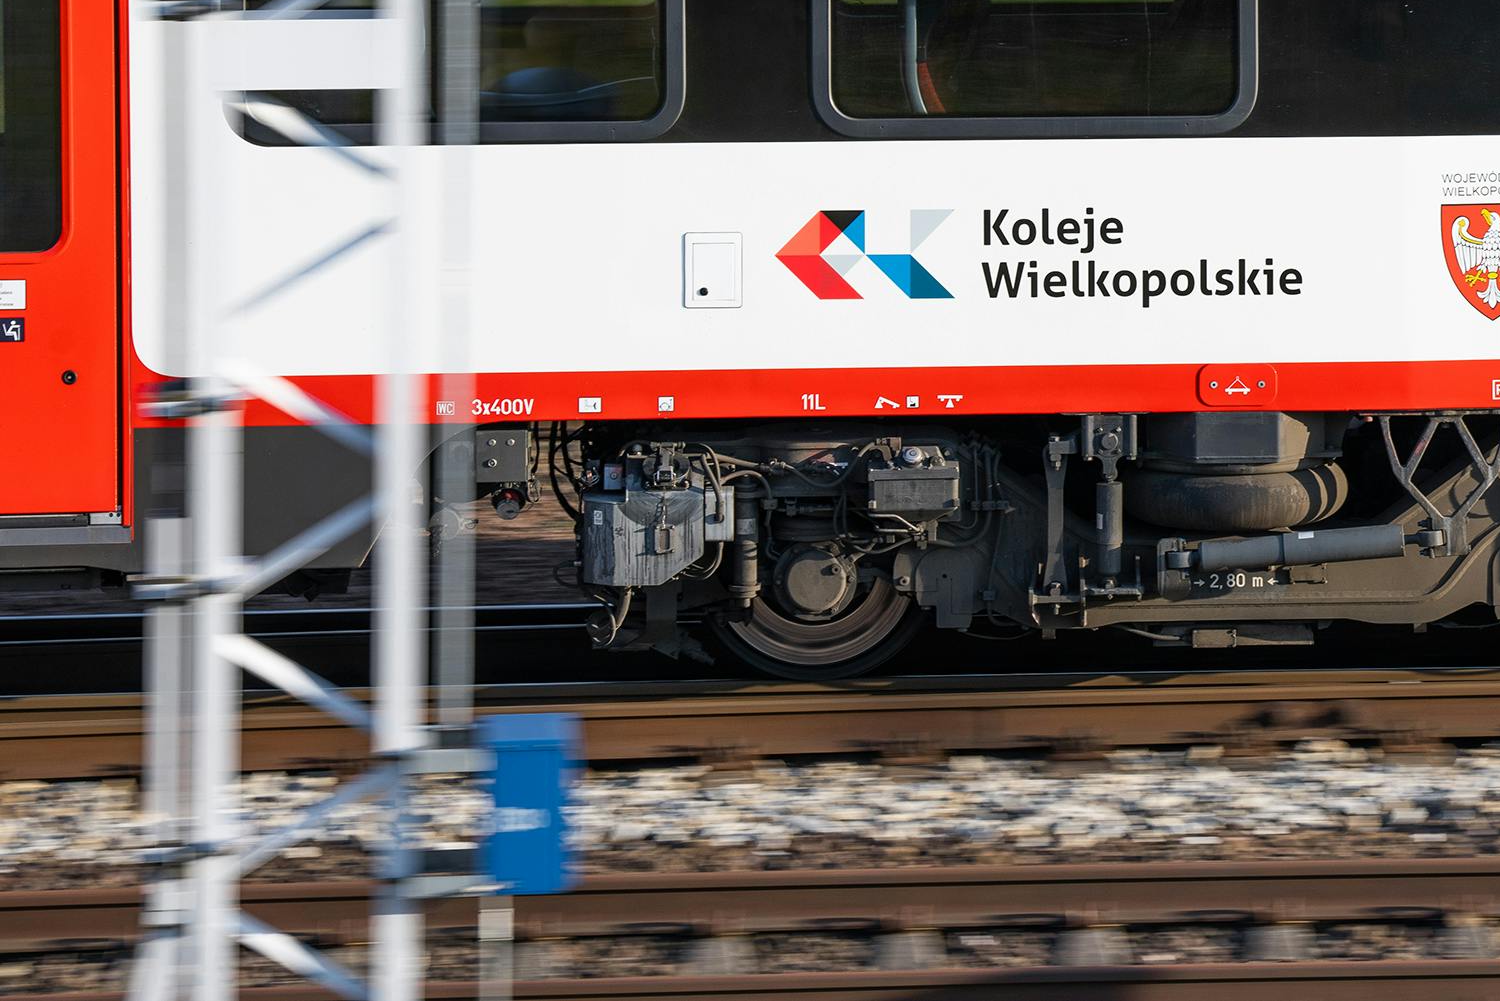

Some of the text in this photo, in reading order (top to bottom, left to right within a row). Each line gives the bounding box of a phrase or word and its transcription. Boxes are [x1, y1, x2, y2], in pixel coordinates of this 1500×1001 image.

[982, 208, 1124, 253] Koleje
[982, 258, 1304, 308] Wielkopolskie
[438, 403, 453, 414] WC
[471, 399, 534, 415] 3x400V
[801, 393, 826, 410] 11L
[1252, 576, 1263, 587] m
